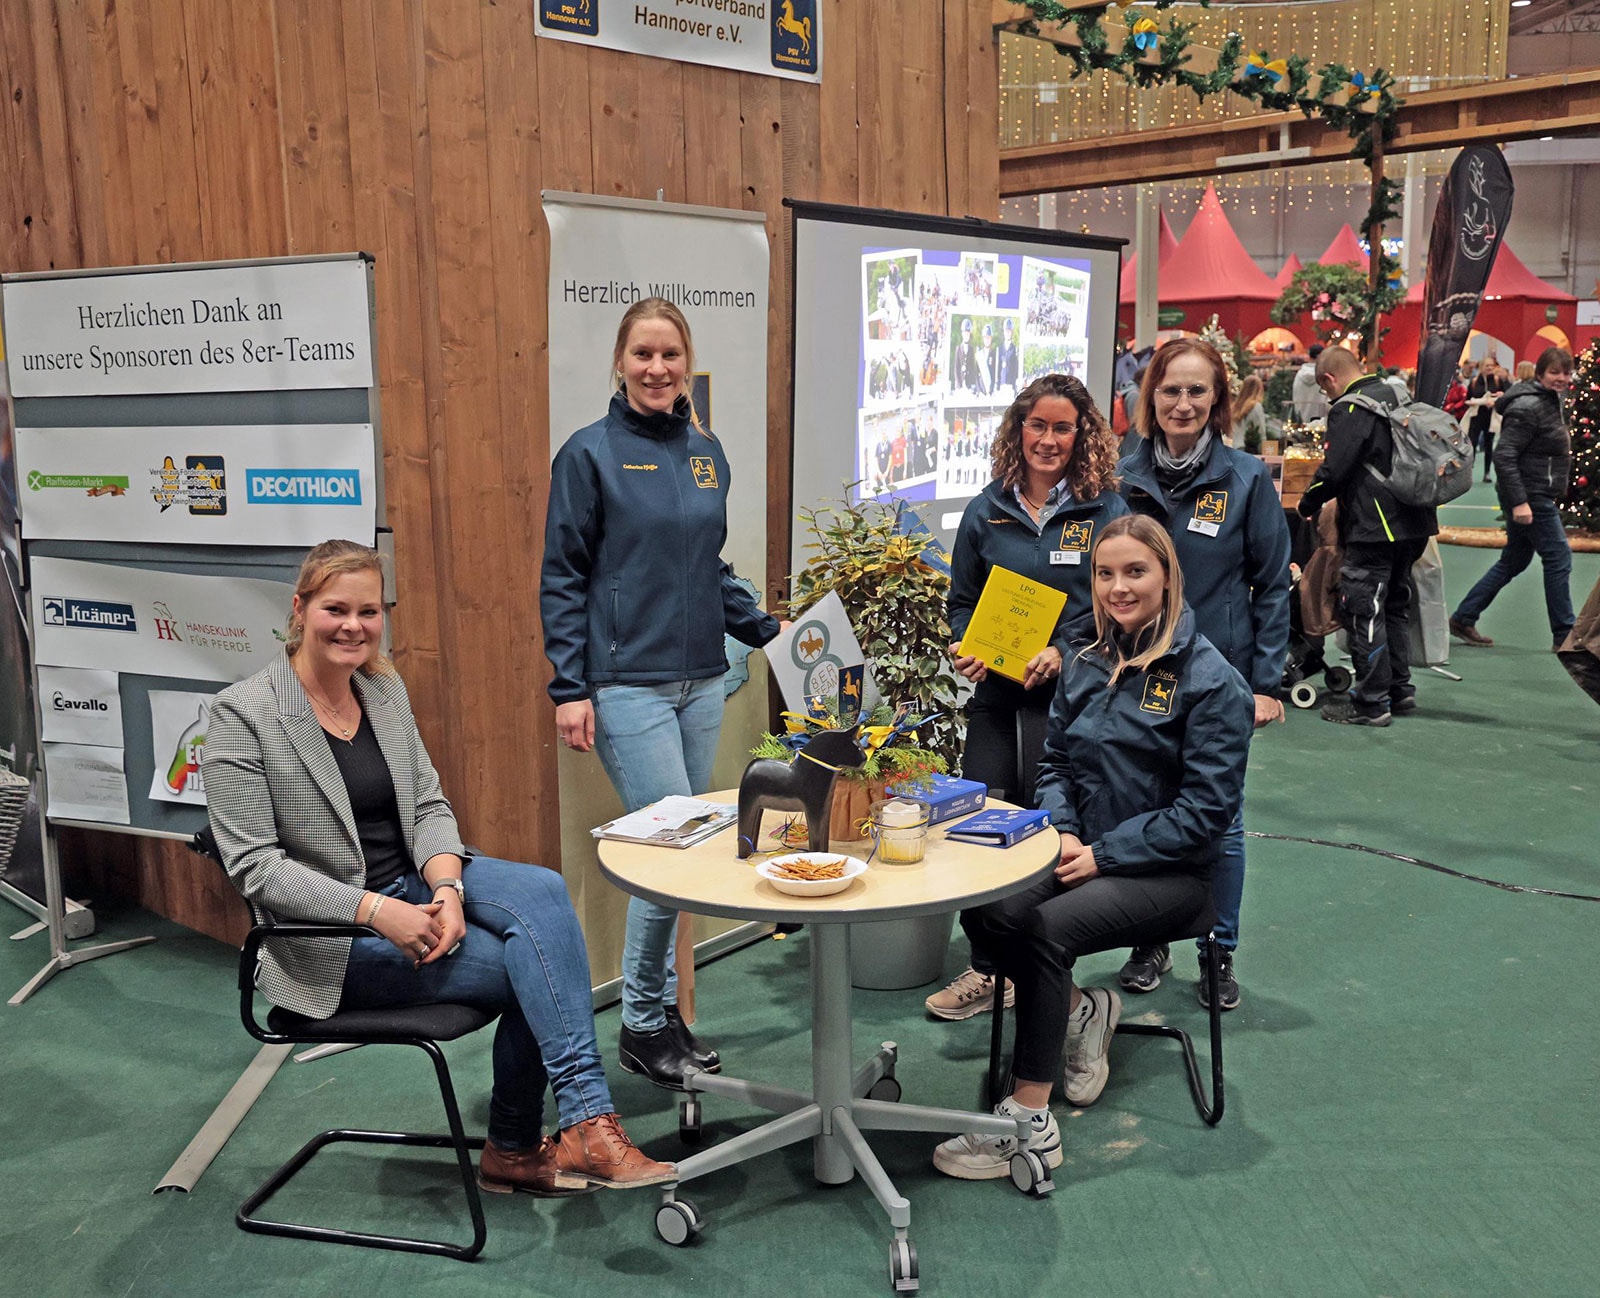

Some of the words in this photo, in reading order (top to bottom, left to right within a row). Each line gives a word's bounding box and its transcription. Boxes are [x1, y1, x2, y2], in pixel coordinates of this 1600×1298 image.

[546, 11, 578, 25] Hannover
[561, 5, 576, 15] PSV
[635, 5, 712, 38] Hannover
[716, 24, 743, 44] e.V.
[564, 280, 641, 304] Herzlich
[648, 283, 755, 308] Willkommen
[77, 302, 185, 330] Herzlichen
[191, 297, 251, 324] Dank
[257, 301, 283, 321] an
[22, 352, 84, 371] unsere
[89, 345, 193, 375] Sponsoren
[200, 340, 235, 365] des
[242, 337, 355, 364] 8er-Teams
[46, 476, 104, 487] Raiffeisen-Markt
[252, 476, 356, 498] DECATHLON
[1019, 583, 1036, 596] LPO
[68, 605, 134, 626] Krämer
[1009, 604, 1029, 618] 2024
[185, 621, 248, 639] HANSEKLINIK
[190, 635, 209, 648] FÜR
[212, 638, 253, 653] PFERDE
[53, 696, 108, 711] Cavallo
